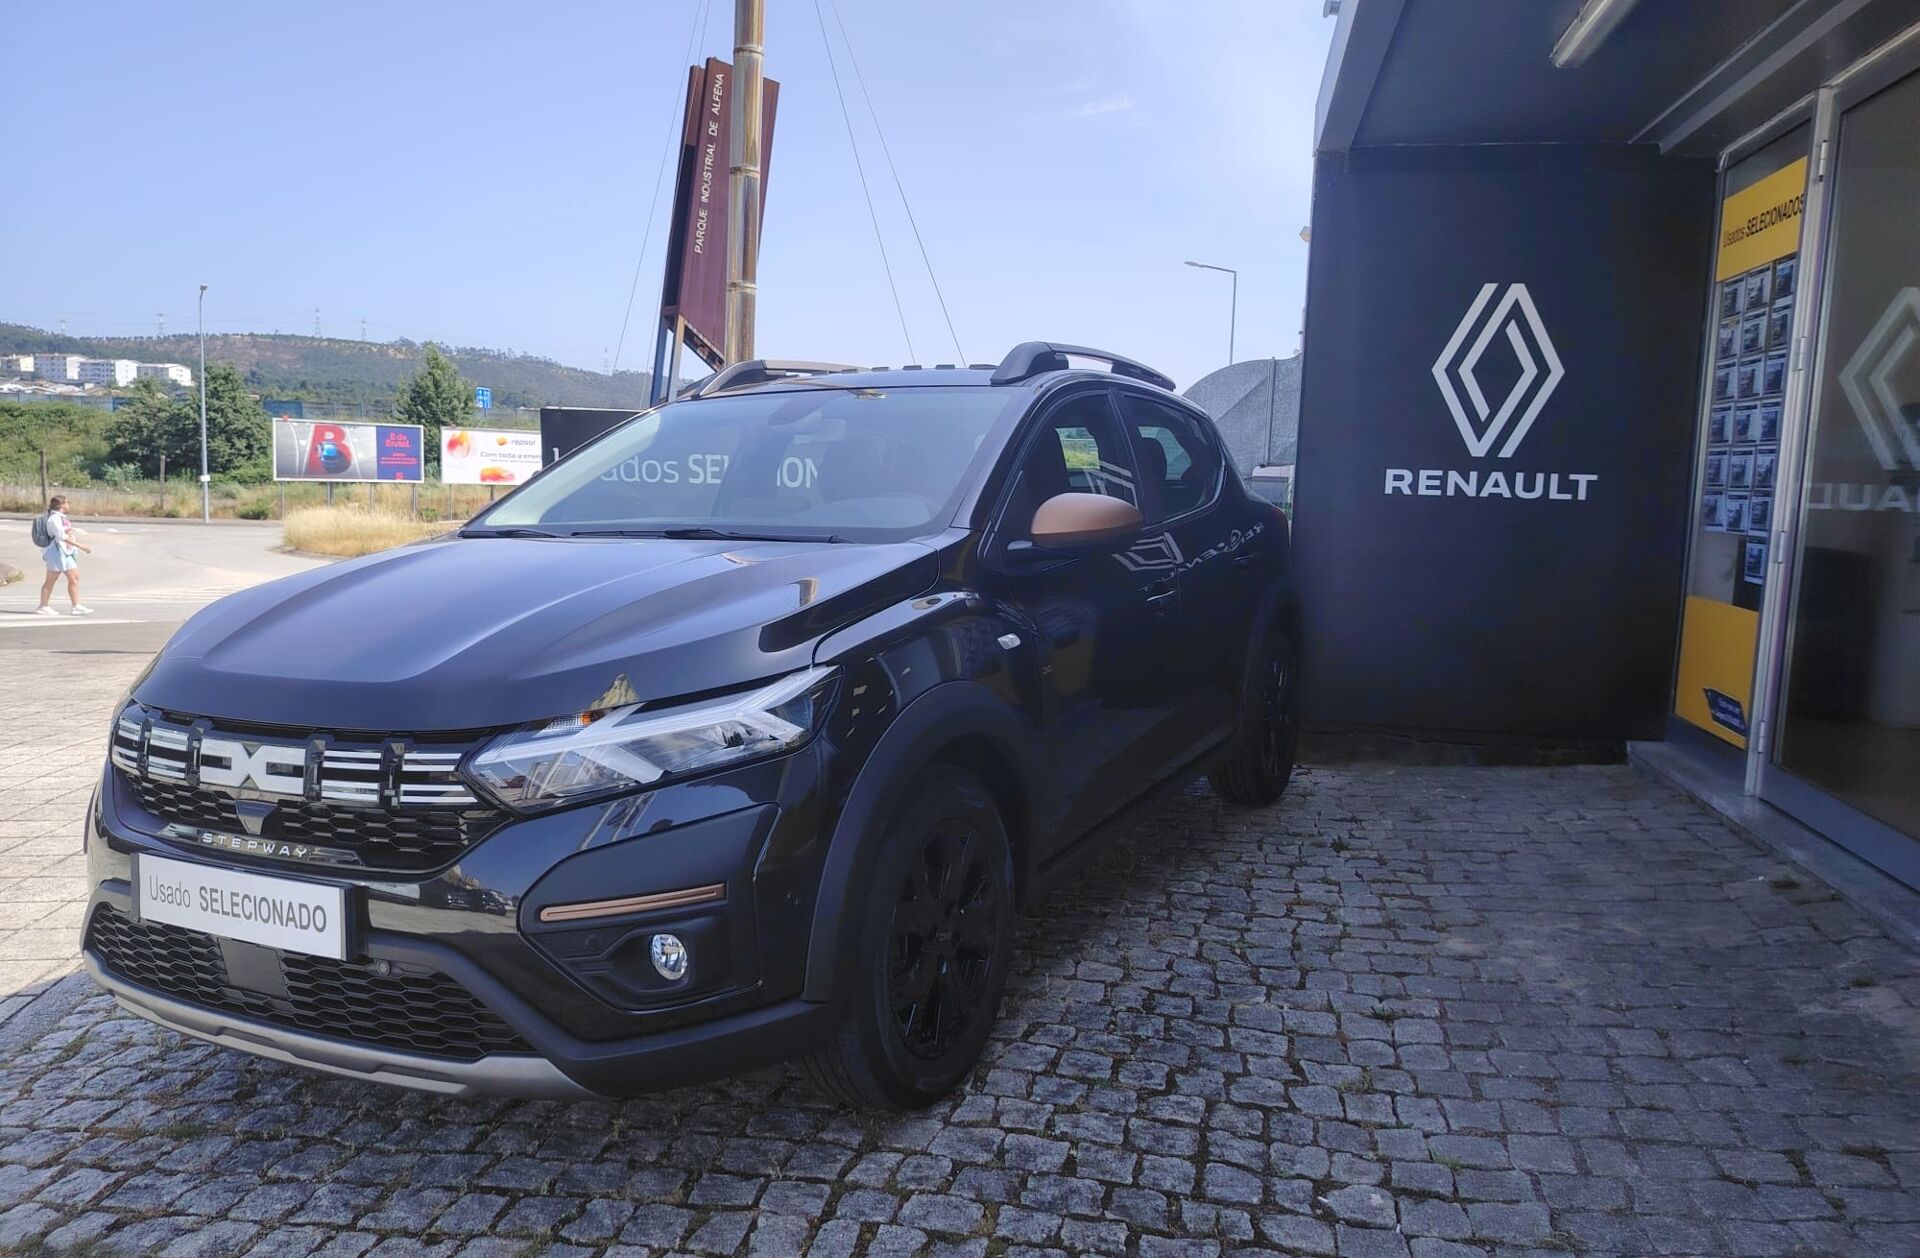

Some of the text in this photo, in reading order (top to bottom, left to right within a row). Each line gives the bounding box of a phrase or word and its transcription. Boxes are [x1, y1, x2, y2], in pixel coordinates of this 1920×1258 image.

[694, 73, 725, 254] PARQUE INDUSTRIAL DE ALFENA
[1722, 193, 1805, 248] Usados SELECIONADOS
[511, 439, 536, 447] repsol
[1384, 468, 1599, 501] RENAULT
[201, 832, 308, 858] STEPWAY
[149, 875, 327, 933] Usado SELECIONADO
